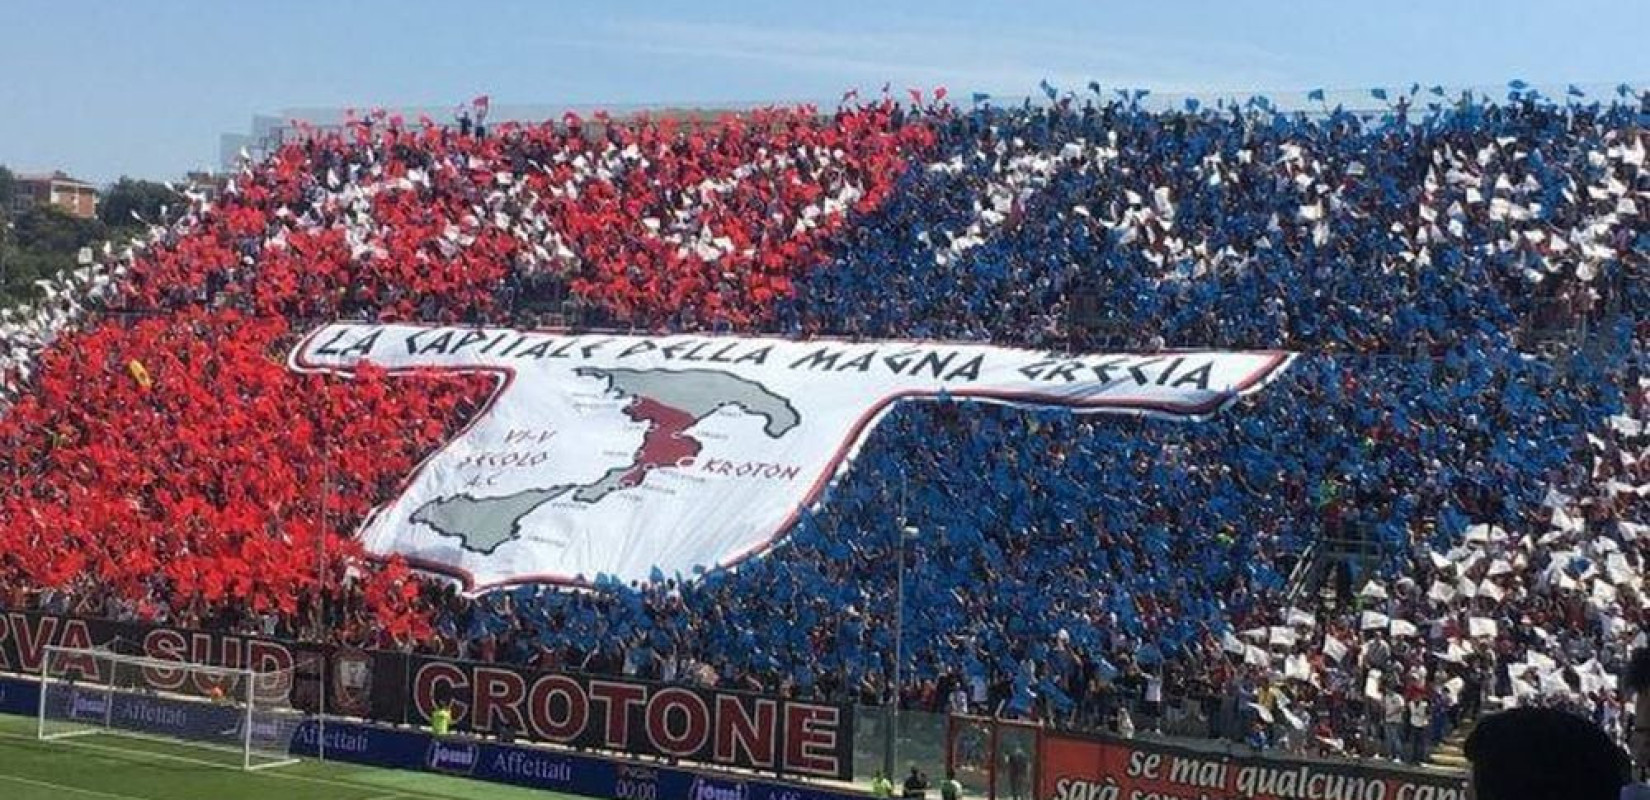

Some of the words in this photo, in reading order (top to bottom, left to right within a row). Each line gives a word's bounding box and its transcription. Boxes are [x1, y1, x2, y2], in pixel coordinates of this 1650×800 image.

[315, 328, 384, 356] LA
[405, 329, 617, 359] CAPITALE
[617, 339, 776, 365] DELLA
[789, 345, 985, 382] MAGNA
[1019, 356, 1214, 390] GRECIA
[702, 457, 801, 480] KROTON
[0, 613, 99, 680] VA
[142, 629, 294, 702] SUD
[414, 662, 839, 774] CROTONE
[492, 751, 572, 781] Affettati
[1127, 750, 1161, 779] se
[1170, 756, 1229, 789] mai
[1236, 764, 1387, 800] qualcuno
